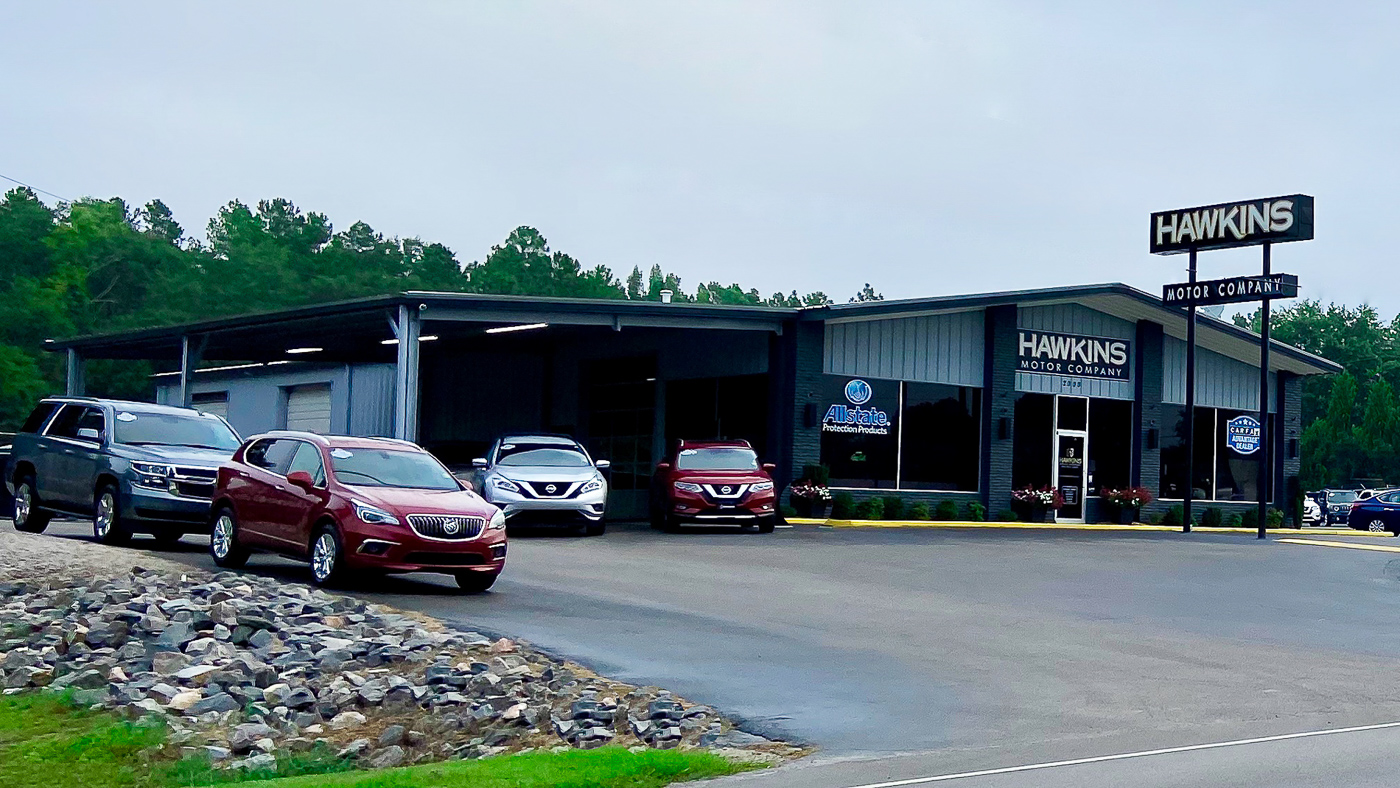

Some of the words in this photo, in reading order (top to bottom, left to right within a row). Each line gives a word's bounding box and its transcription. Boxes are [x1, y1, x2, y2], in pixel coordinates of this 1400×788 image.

[1156, 200, 1294, 246] HAWKINS
[1167, 285, 1209, 301] MOTOR
[1218, 278, 1281, 297] COMPANY
[1019, 332, 1127, 365] HAWKINS
[1021, 360, 1062, 372] MOTOR
[1068, 364, 1122, 377] COMPANY
[823, 405, 887, 426] Allstate
[823, 423, 857, 433] Protection
[858, 425, 887, 434] Products
